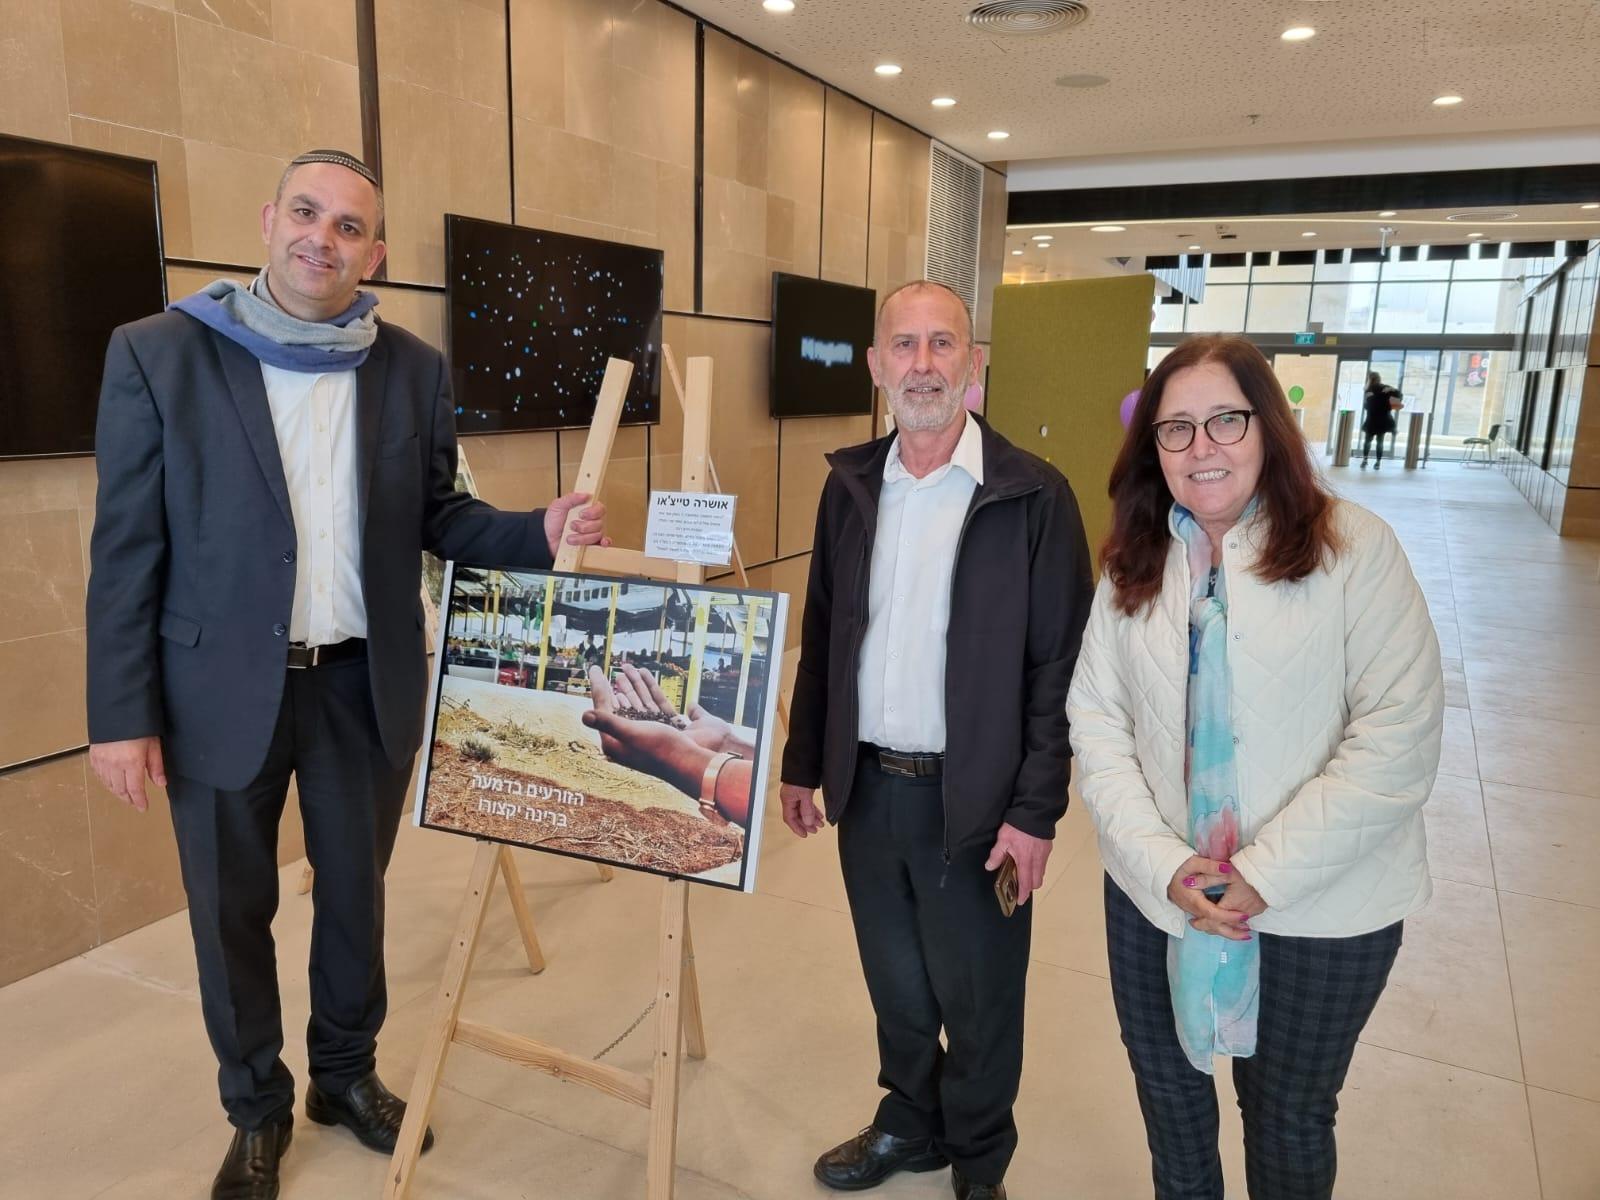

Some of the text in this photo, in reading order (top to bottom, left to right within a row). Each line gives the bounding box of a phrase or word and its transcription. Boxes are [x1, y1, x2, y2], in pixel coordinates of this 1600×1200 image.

[694, 499, 729, 510] אושרה
[471, 774, 585, 806] הזורעים בדמעה
[478, 797, 568, 827] ברינה יקצורו
